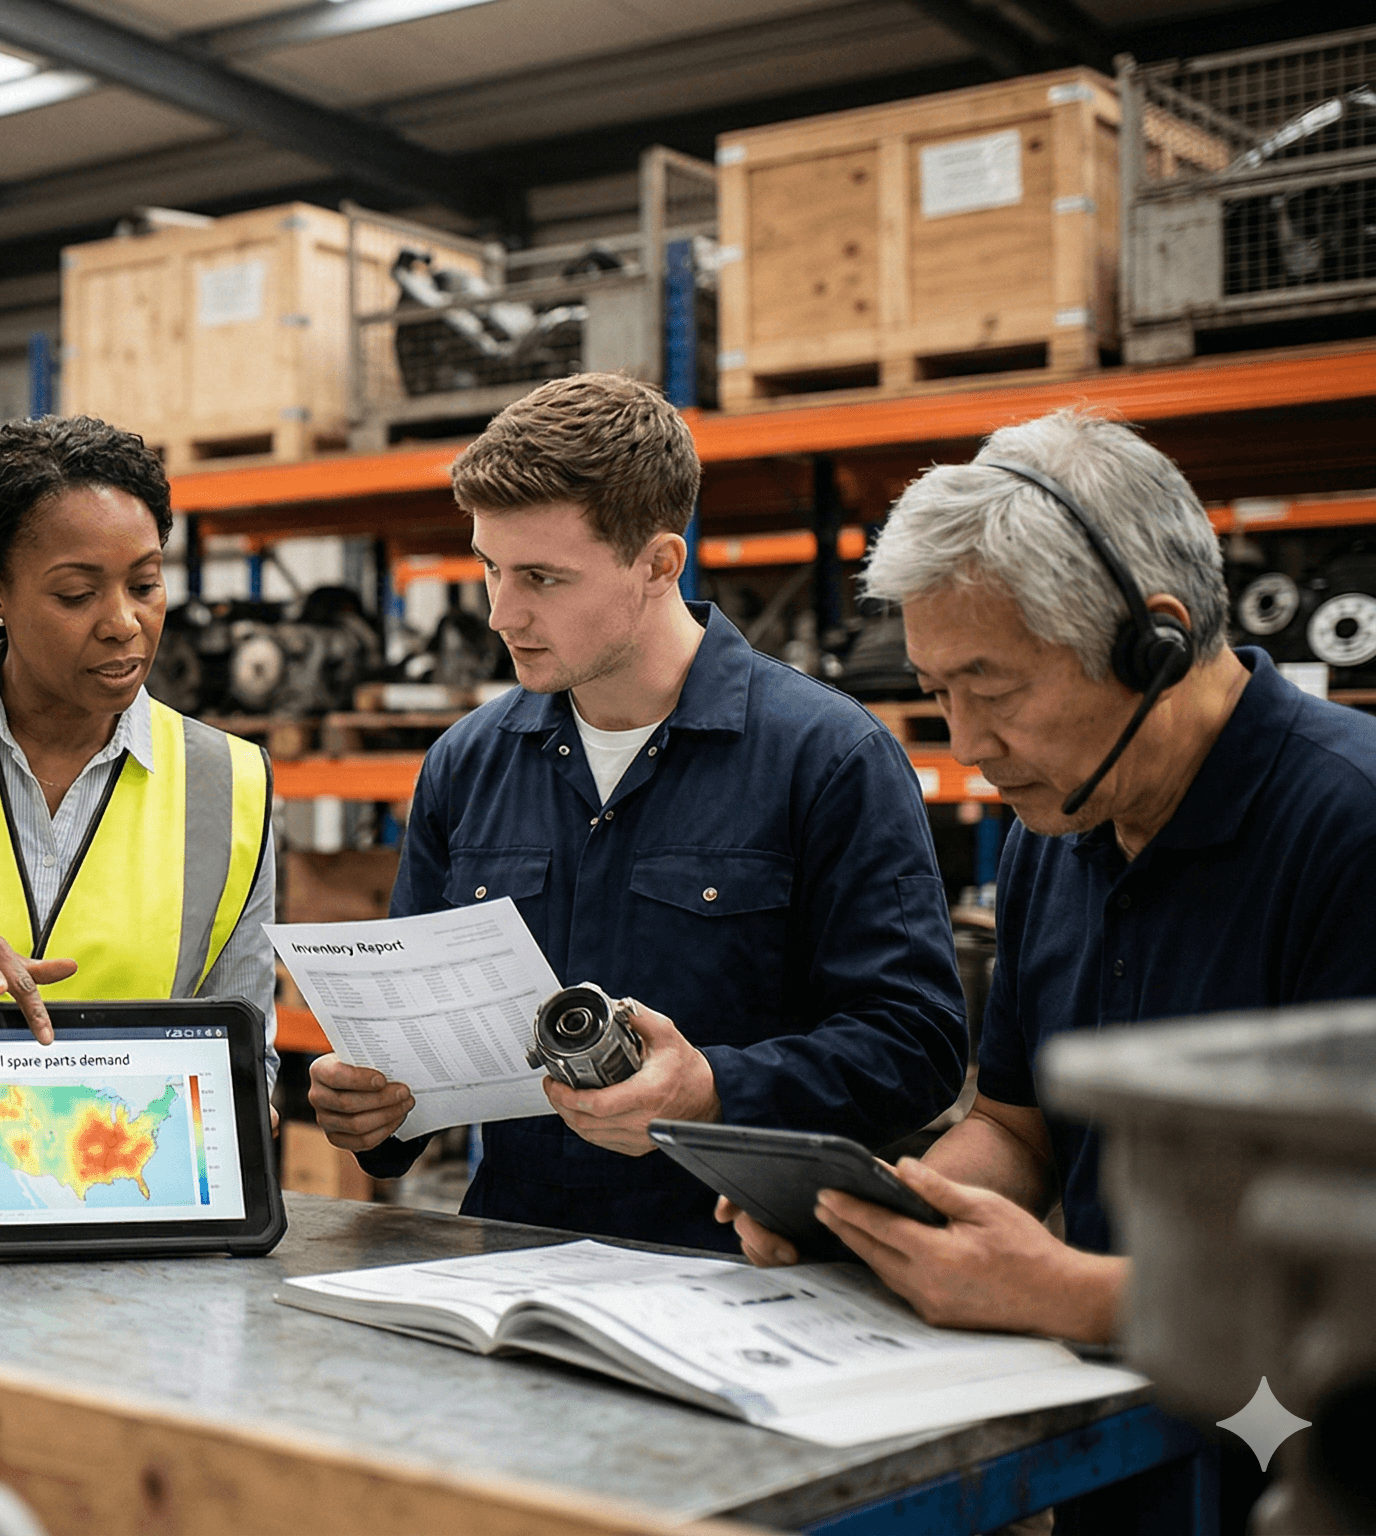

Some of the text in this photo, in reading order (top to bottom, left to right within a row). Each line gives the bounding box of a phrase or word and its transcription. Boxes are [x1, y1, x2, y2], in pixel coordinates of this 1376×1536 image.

[7, 1055, 42, 1070] spare
[45, 1056, 77, 1069] parts
[79, 1054, 130, 1066] demand
